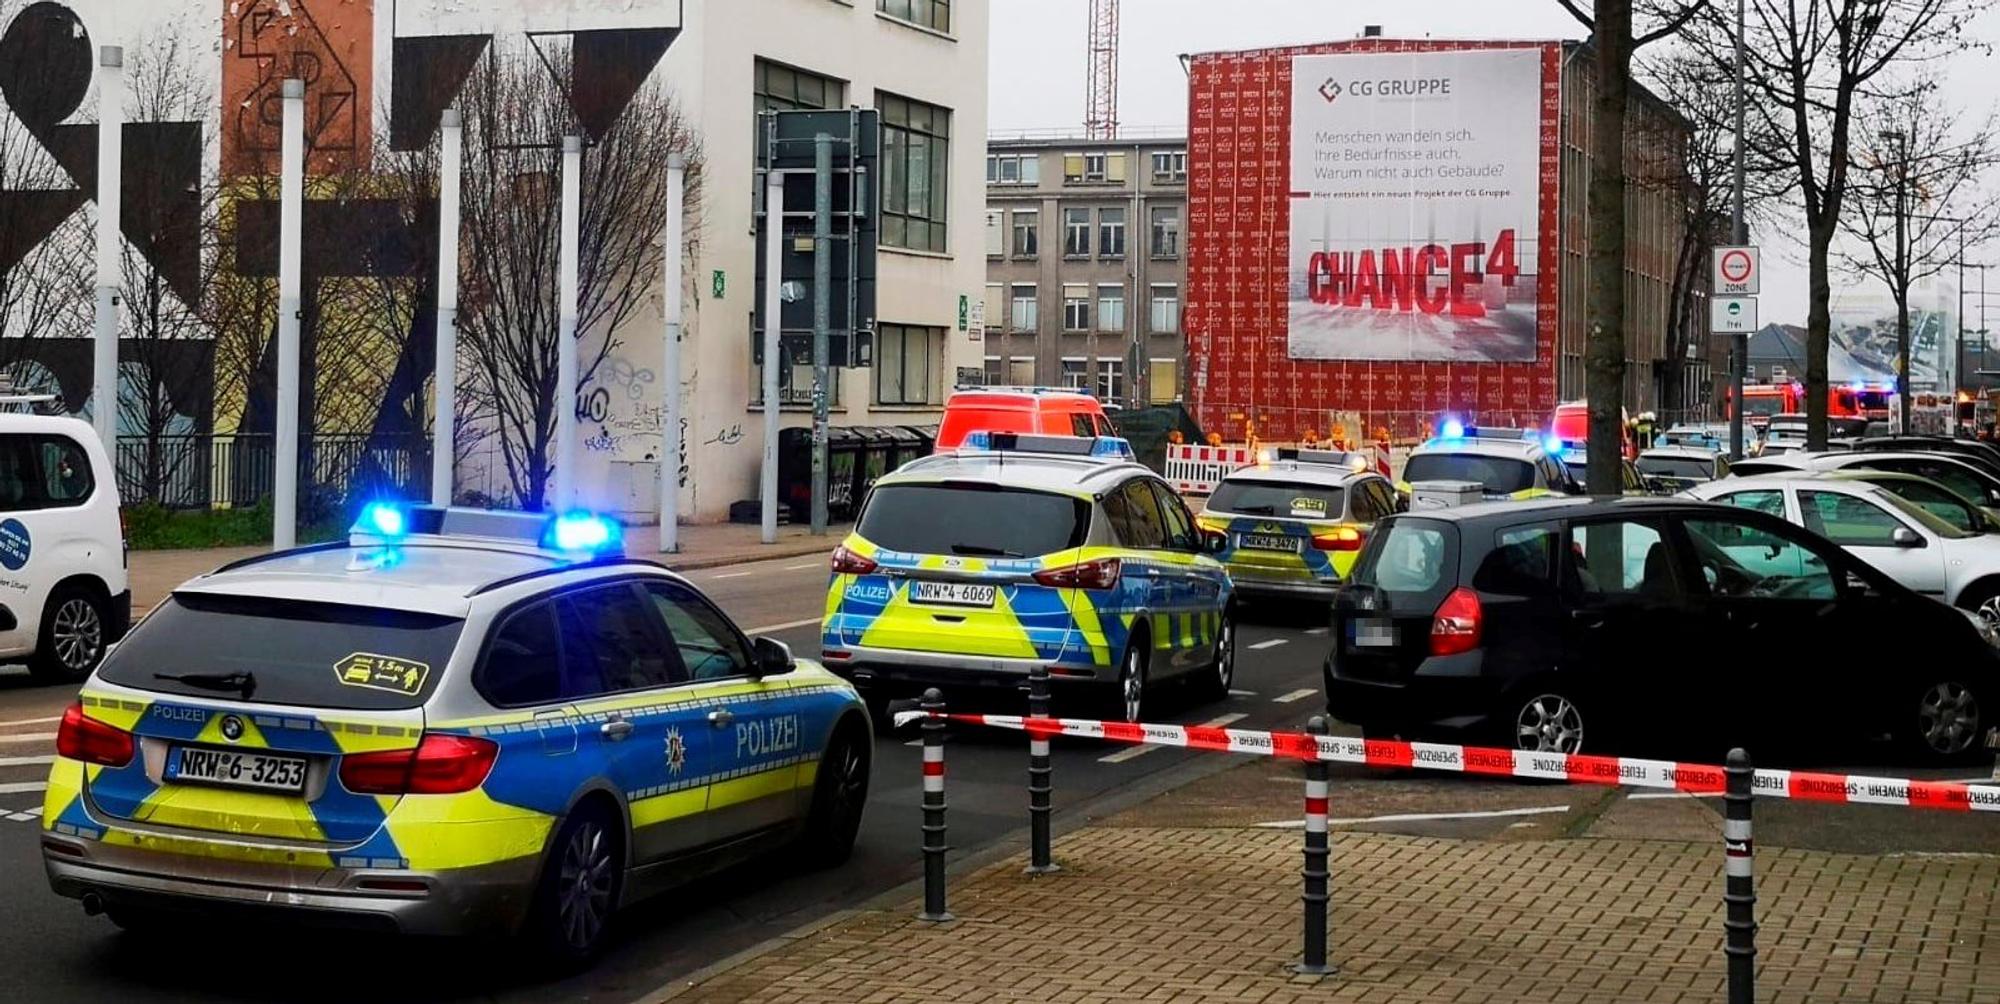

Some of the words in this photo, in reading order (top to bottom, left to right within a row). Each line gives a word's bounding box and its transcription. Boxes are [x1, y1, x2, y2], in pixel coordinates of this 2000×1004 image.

[1349, 80, 1373, 96] CG
[1377, 78, 1451, 96] GRUPPE
[1315, 130, 1382, 144] Menschen
[1385, 128, 1442, 143] wandeln
[1445, 127, 1475, 142] sich.
[1314, 147, 1340, 161] Ihre
[1426, 146, 1461, 160] auch.
[1314, 166, 1362, 180] Warum
[1366, 166, 1397, 179] nicht
[1401, 164, 1433, 178] auch
[1313, 190, 1332, 199] Hier
[1333, 190, 1369, 199] entsteht
[1371, 190, 1384, 199] ein
[1386, 190, 1412, 199] neues
[1414, 189, 1446, 200] Projekt
[1447, 188, 1462, 198] der
[1464, 187, 1477, 197] CG
[1725, 283, 1748, 293] ZONE
[845, 584, 890, 600] POLIZEI
[916, 582, 944, 600] NRW
[948, 585, 994, 602] 4-6069
[152, 704, 206, 723] POLIZEI
[735, 713, 798, 759] POLIZEI
[1408, 748, 1458, 764] SPERRZONE
[1466, 751, 1517, 768] FEUERWEHR
[179, 749, 220, 778] NRW
[229, 754, 305, 787] 6-3253
[1532, 758, 1583, 774] SPERRZONE
[1591, 762, 1647, 779] FEUERWEHR
[1661, 768, 1718, 786] SPERRZONE
